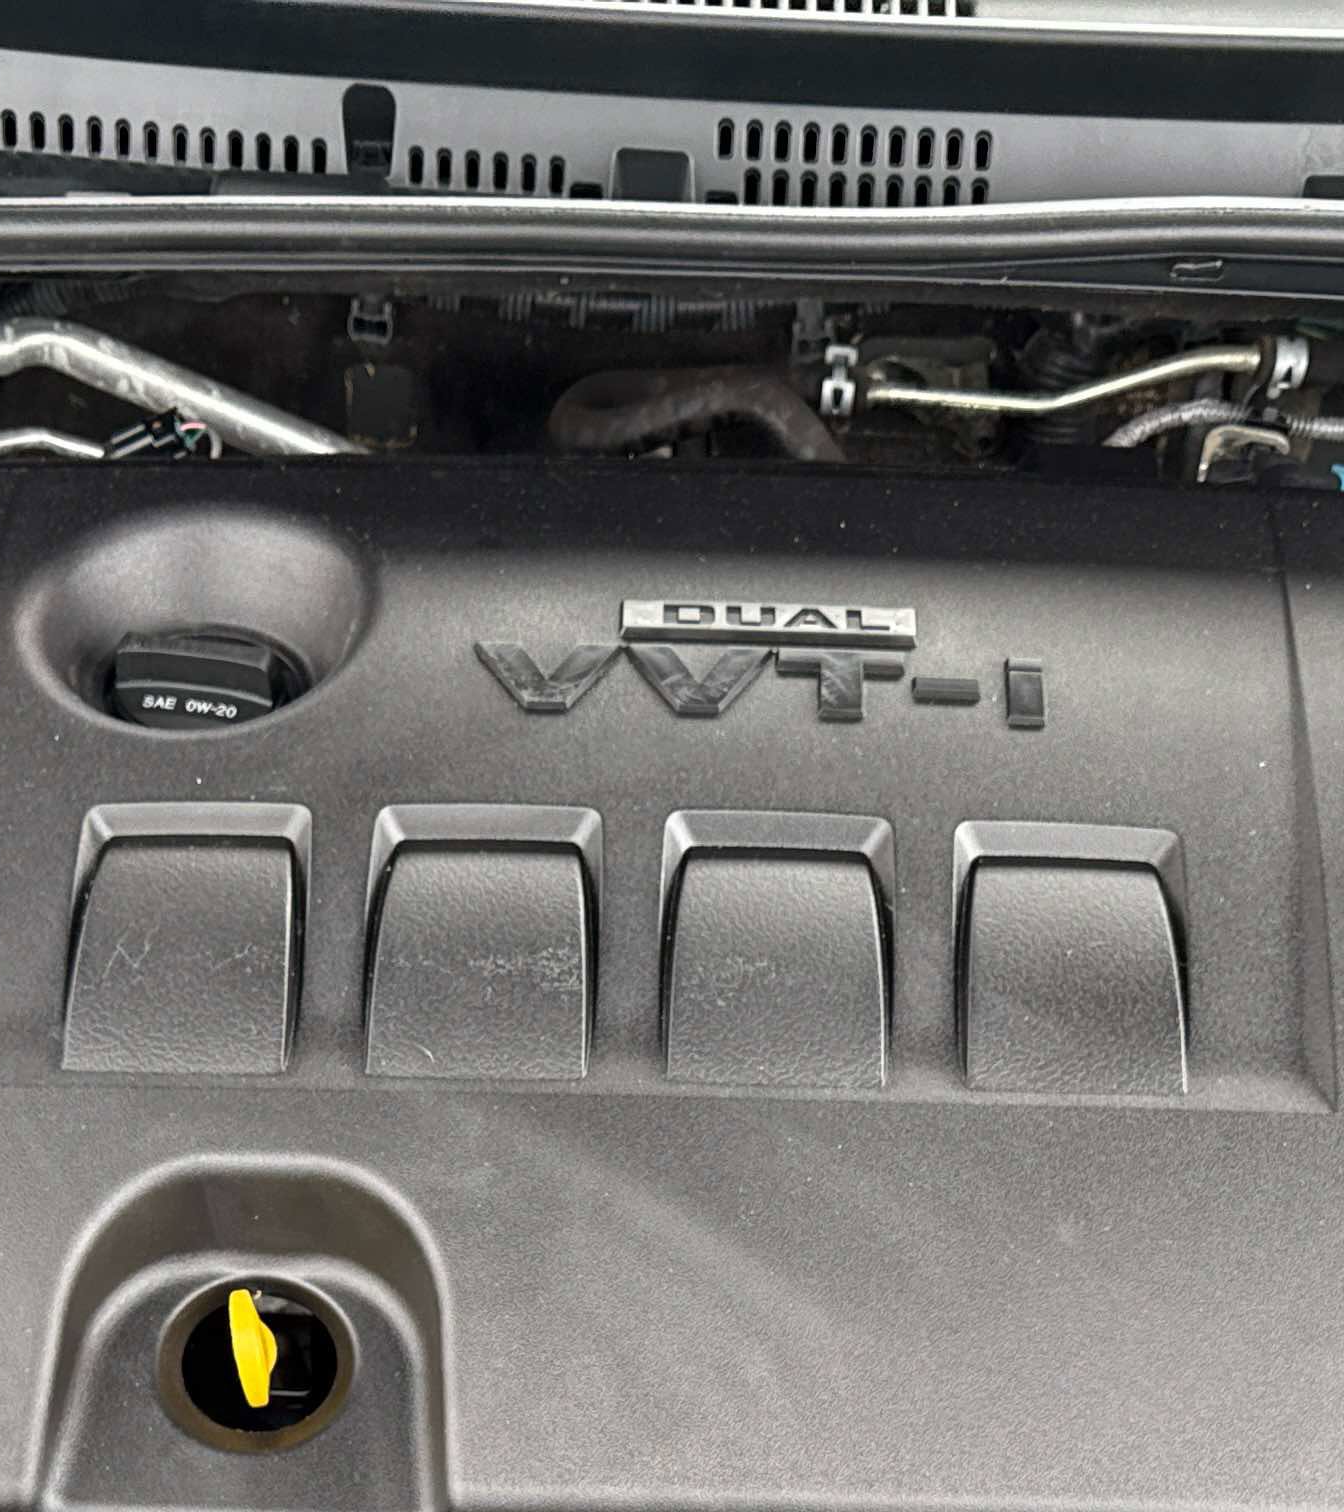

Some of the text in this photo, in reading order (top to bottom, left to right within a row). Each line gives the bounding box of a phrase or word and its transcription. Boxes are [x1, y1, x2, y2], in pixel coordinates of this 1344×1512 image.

[661, 603, 891, 630] DUAL
[142, 694, 238, 719] SAE 0W-20
